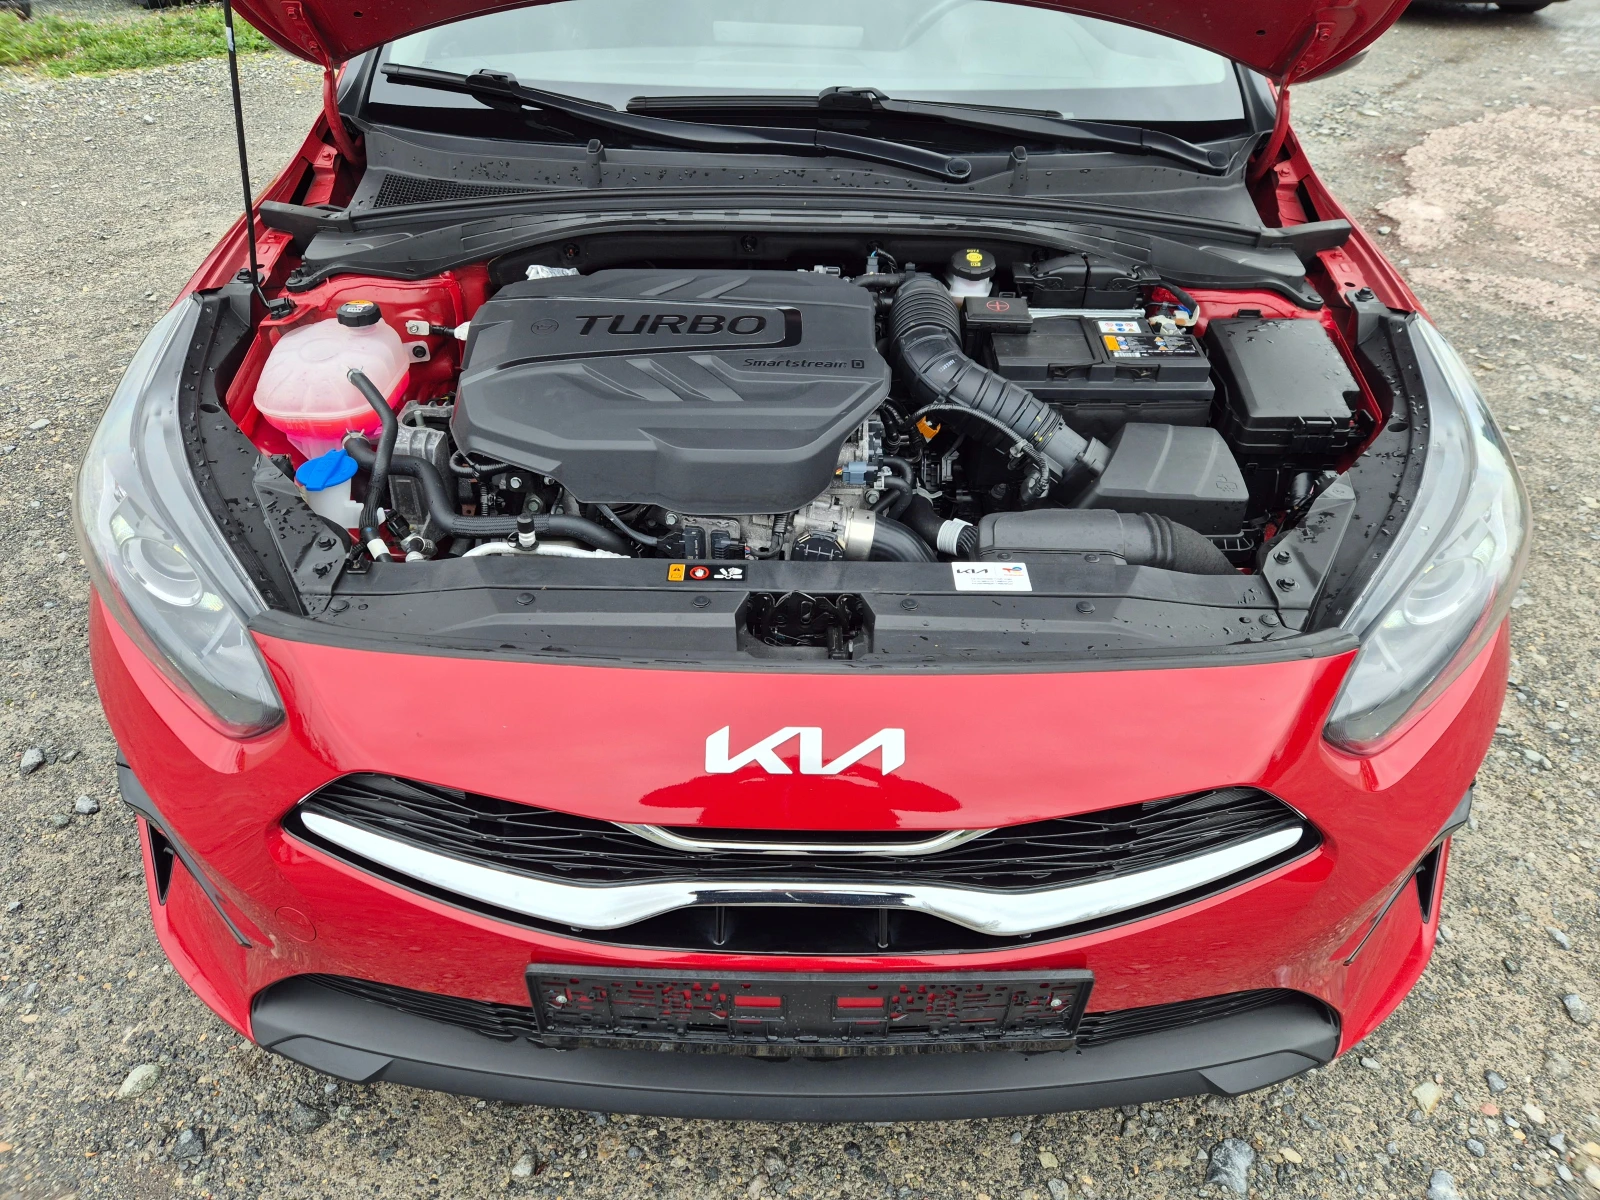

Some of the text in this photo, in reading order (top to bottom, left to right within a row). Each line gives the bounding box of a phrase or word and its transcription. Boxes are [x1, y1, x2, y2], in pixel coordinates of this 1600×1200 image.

[575, 314, 767, 336] TURBO
[743, 358, 847, 369] Smartstream
[704, 725, 906, 776] KIA
